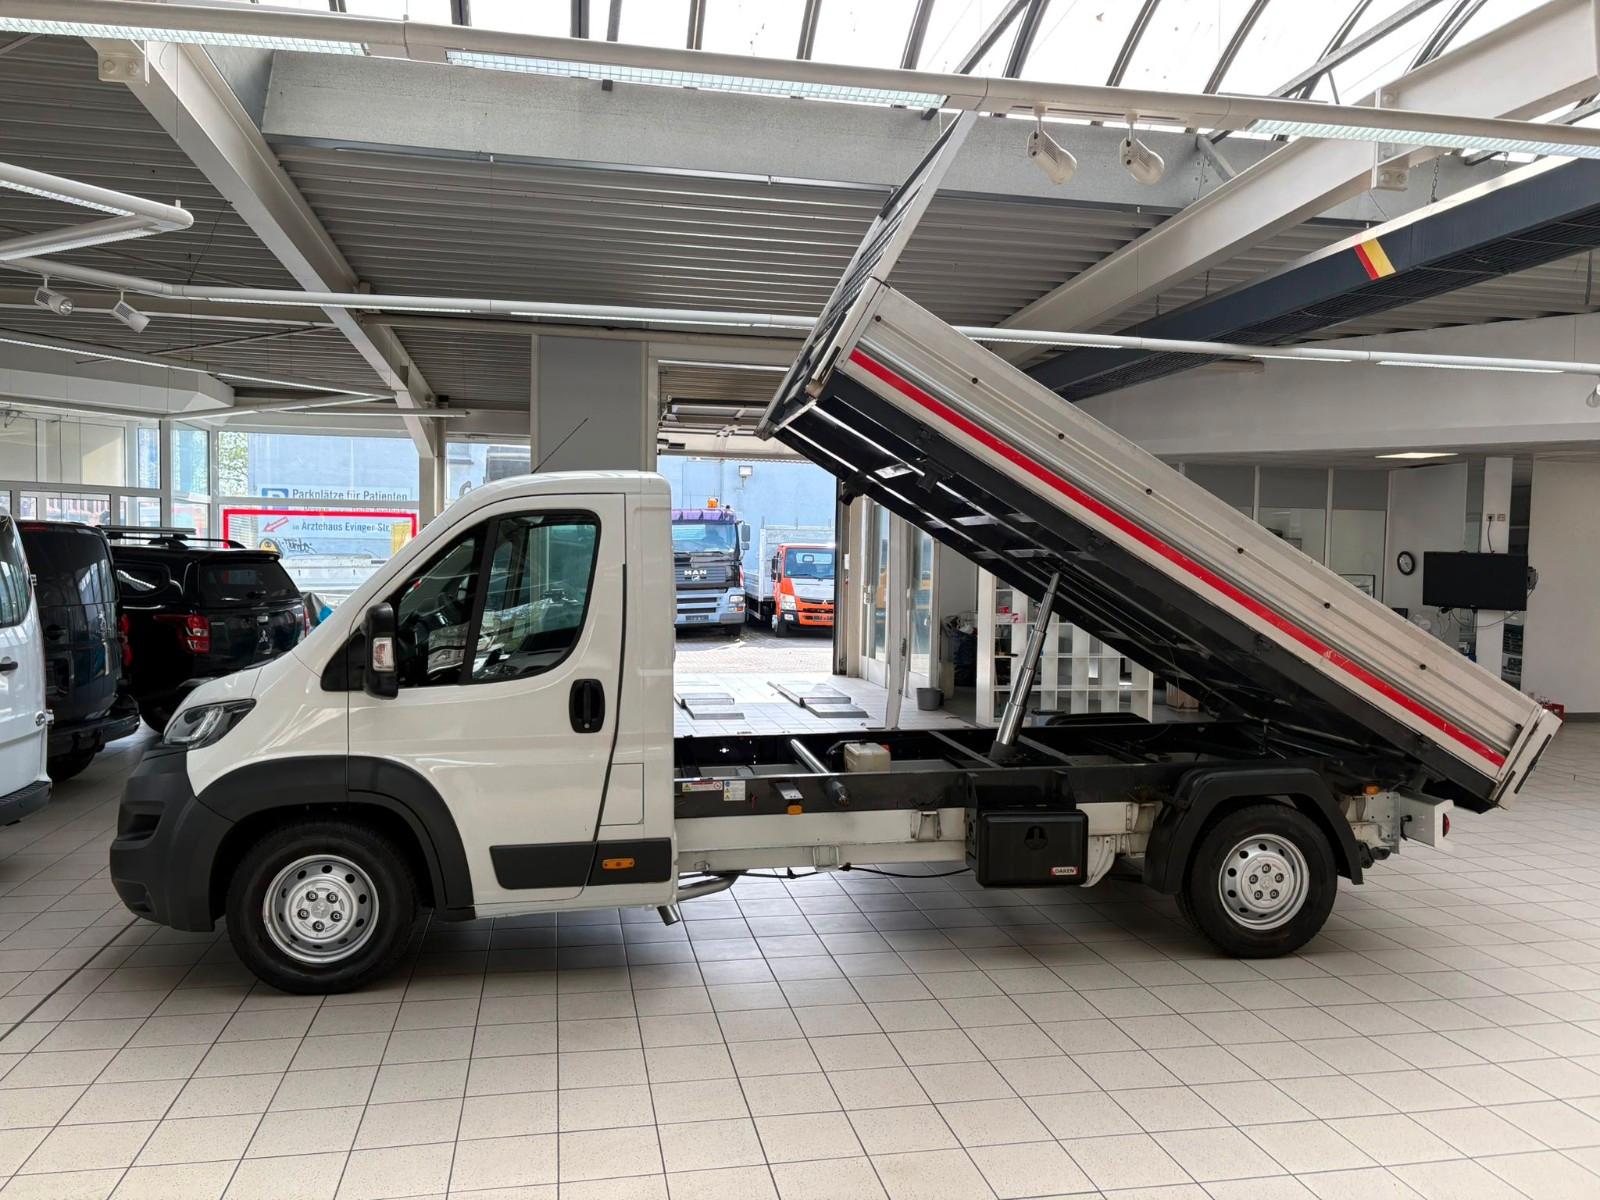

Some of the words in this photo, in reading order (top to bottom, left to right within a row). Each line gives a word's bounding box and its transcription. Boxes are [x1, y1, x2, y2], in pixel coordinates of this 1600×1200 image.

[292, 488, 344, 499] Parkplätze
[347, 489, 361, 500] für
[363, 490, 408, 501] Patienten
[345, 521, 375, 533] Evinger
